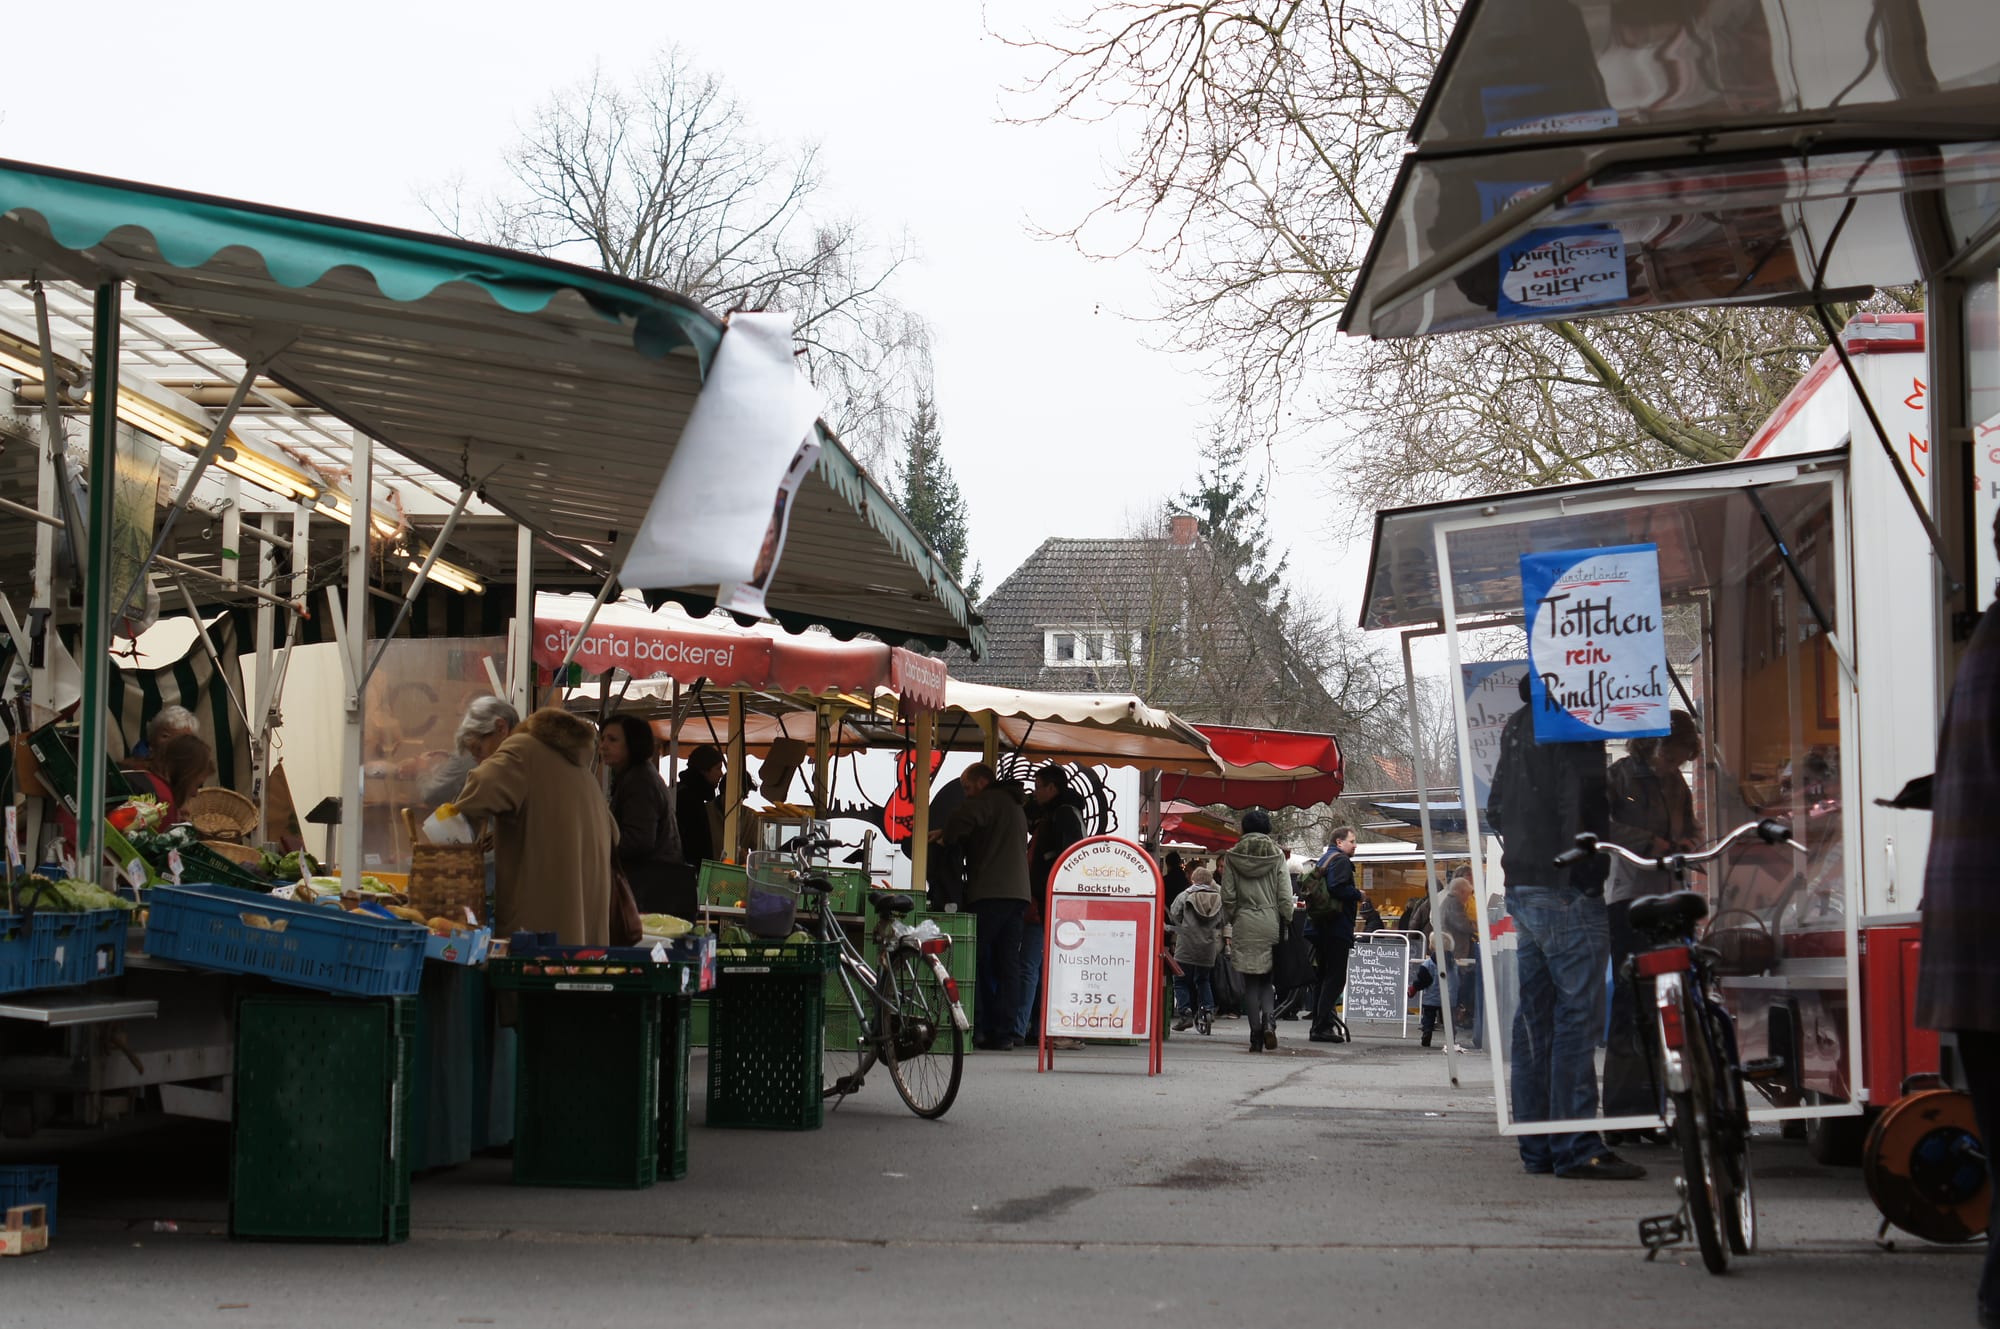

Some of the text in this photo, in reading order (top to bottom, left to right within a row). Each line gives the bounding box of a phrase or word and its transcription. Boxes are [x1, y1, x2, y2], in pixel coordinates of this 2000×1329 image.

[1551, 567, 1629, 584] Münsterländer
[1536, 593, 1657, 638] Töttchen
[634, 637, 735, 667] bäckerei
[1566, 641, 1611, 665] rein
[1539, 665, 1664, 725] Rindfleisch
[1063, 845, 1148, 874] frisch aus unserer
[1077, 883, 1131, 893] Backstube
[1058, 953, 1131, 966] NussMohn-
[1080, 970, 1108, 982] Brot
[1070, 993, 1117, 1005] 3,35 €
[1060, 1012, 1124, 1029] cibaria
